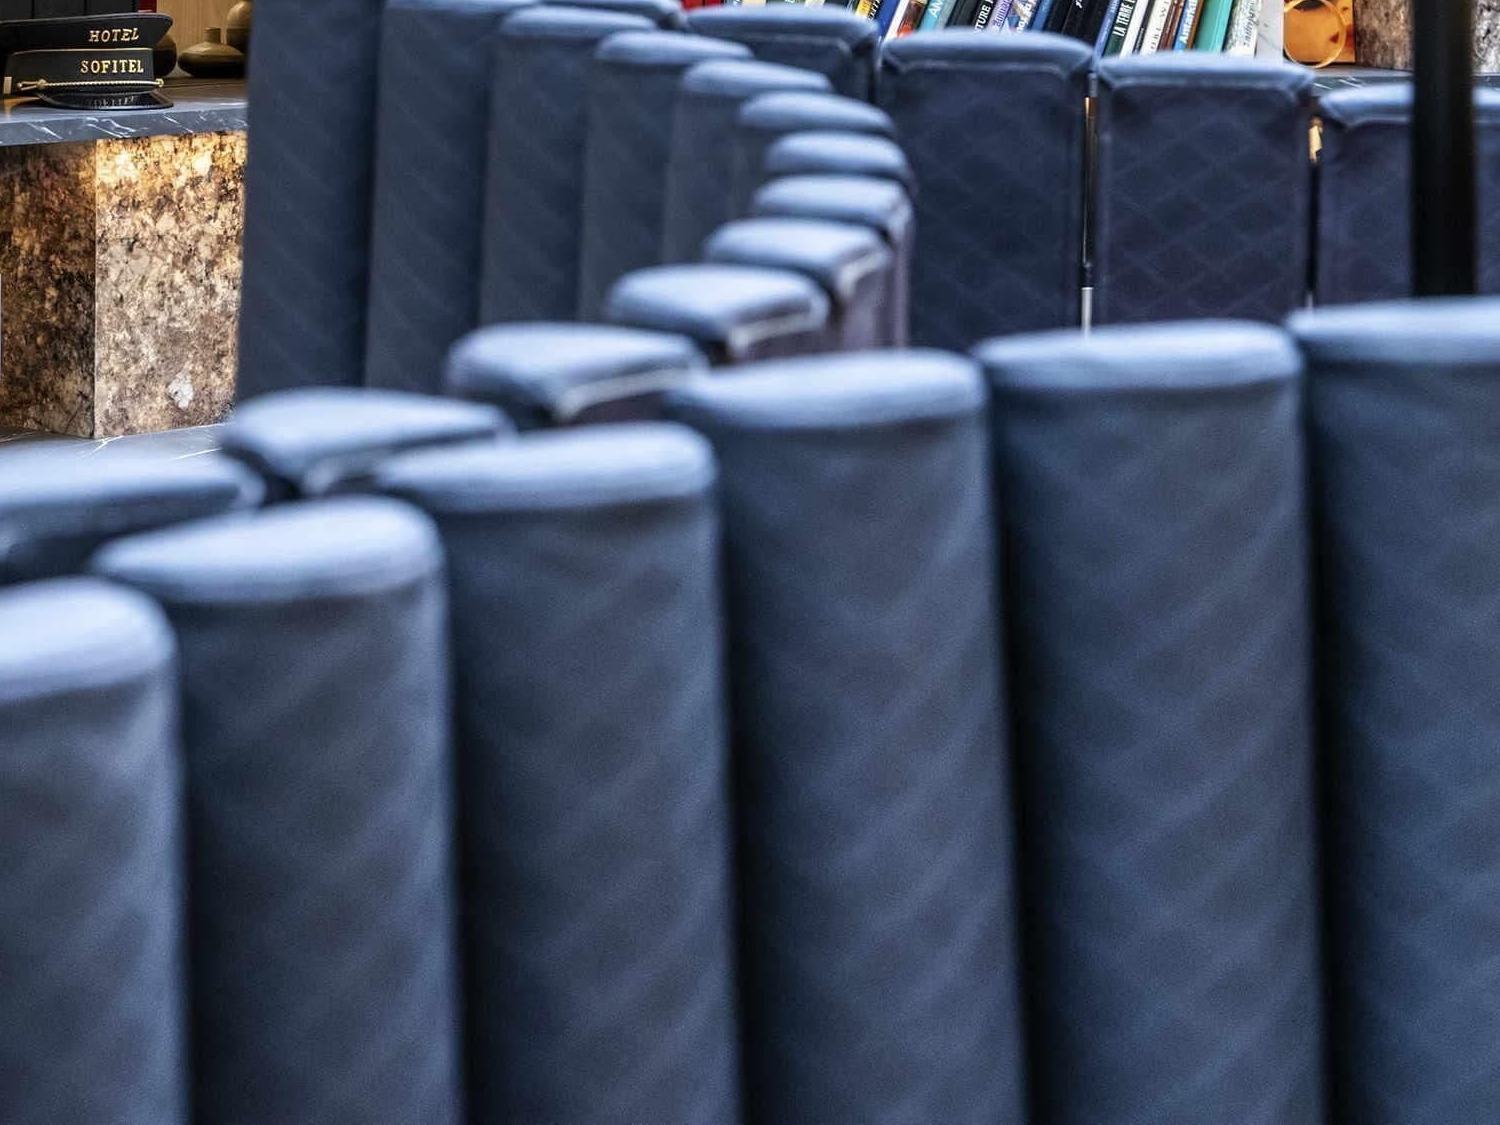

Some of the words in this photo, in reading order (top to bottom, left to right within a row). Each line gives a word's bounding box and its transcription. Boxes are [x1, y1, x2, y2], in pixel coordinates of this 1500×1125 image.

[975, 5, 991, 33] TURE
[1115, 2, 1134, 25] TERRE
[88, 28, 140, 42] HOTEL
[1112, 24, 1127, 37] LA
[80, 60, 143, 74] SOFITEL
